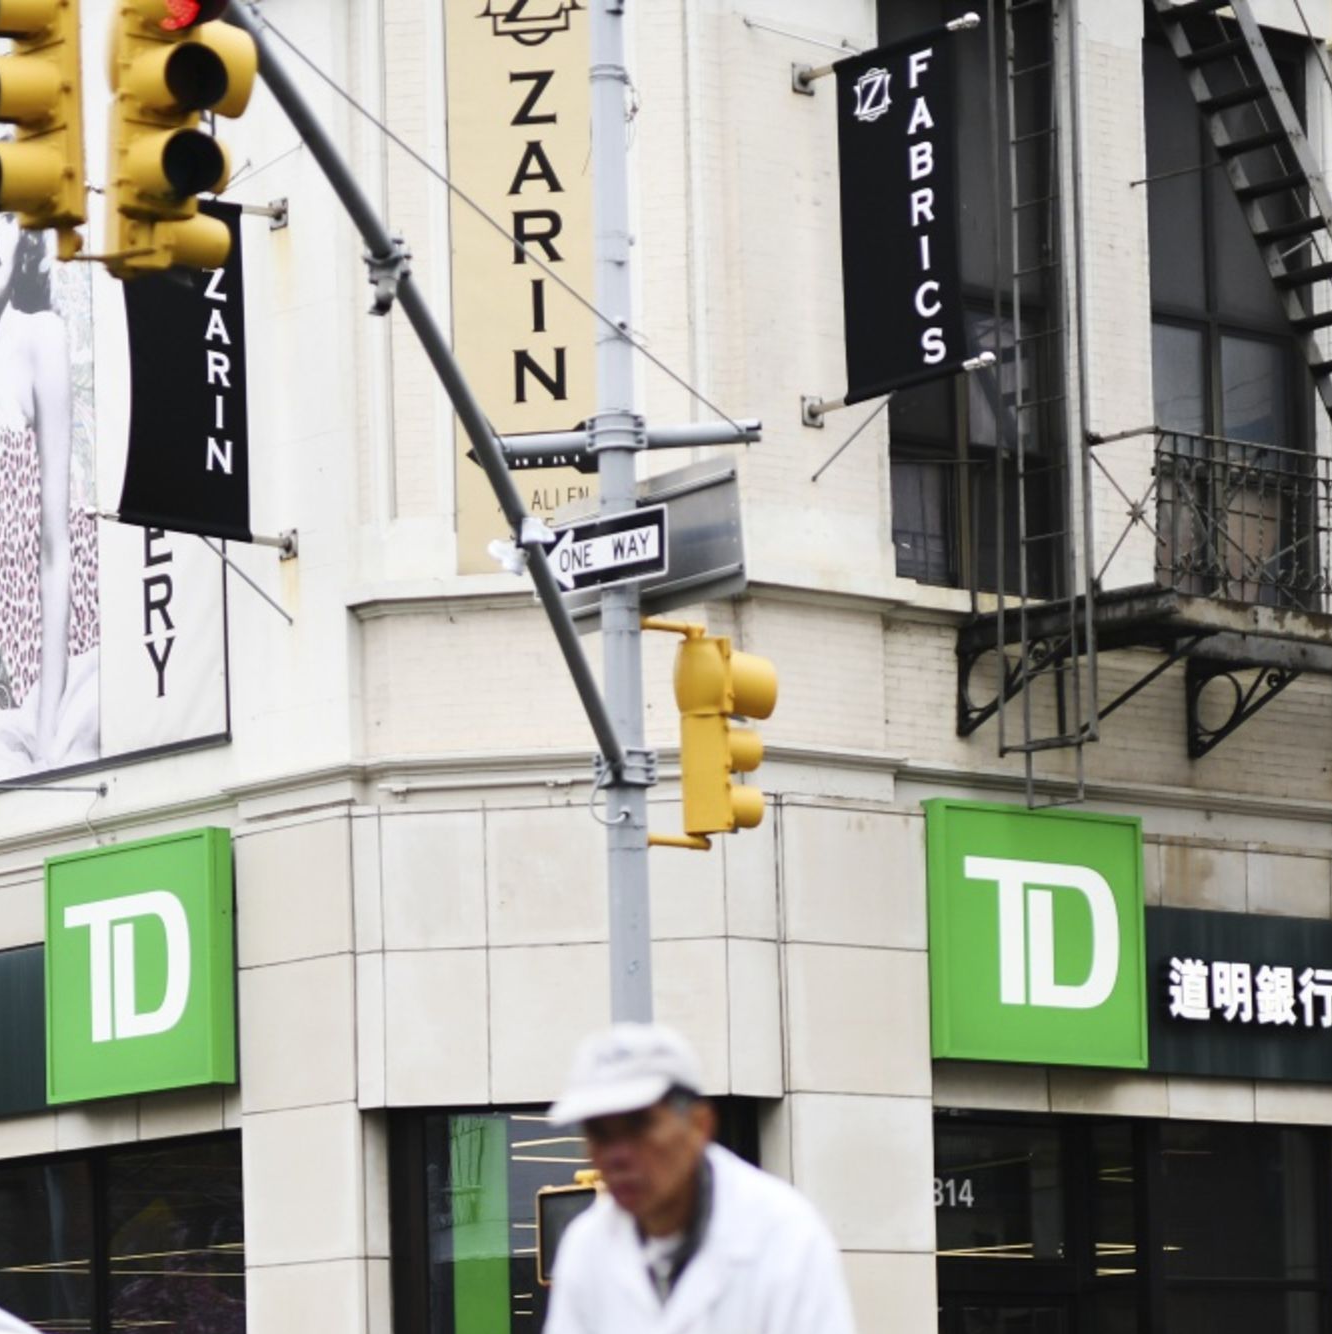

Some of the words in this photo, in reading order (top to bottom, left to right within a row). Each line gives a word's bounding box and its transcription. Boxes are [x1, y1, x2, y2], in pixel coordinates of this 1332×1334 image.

[507, 70, 568, 404] ZARIN
[908, 48, 946, 364] FABRICS
[201, 268, 234, 476] ZARIN
[559, 543, 594, 573] ONE
[612, 531, 651, 561] WAY
[64, 890, 191, 1044] TD
[964, 855, 1120, 1009] TD
